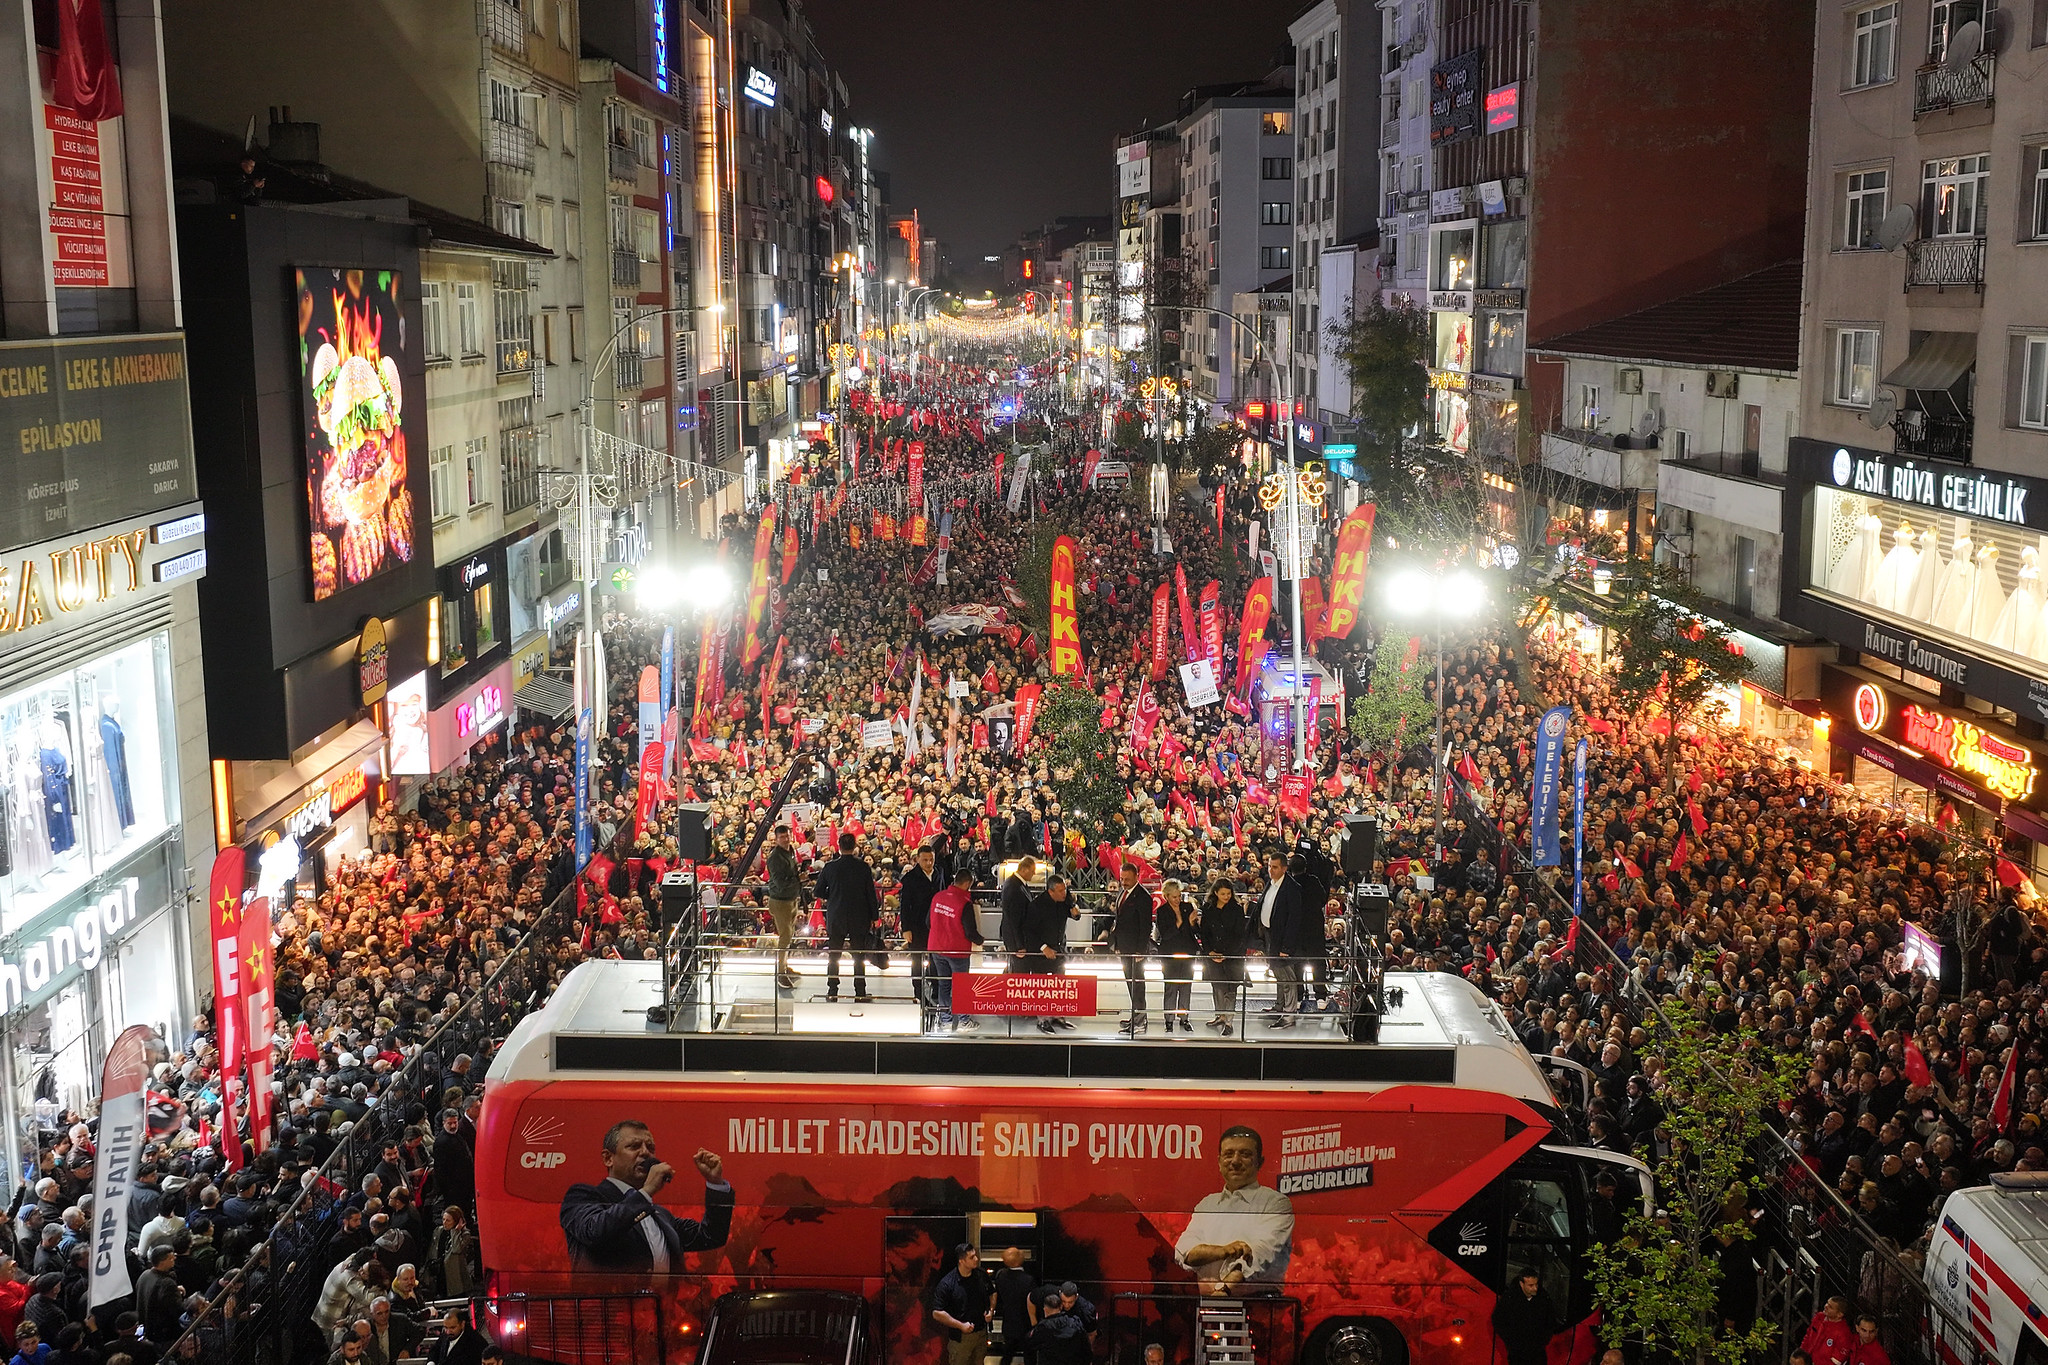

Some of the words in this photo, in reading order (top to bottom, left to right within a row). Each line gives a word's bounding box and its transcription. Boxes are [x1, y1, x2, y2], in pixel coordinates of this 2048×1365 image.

[62, 140, 77, 152] LEKE
[60, 165, 73, 180] KAŞ
[65, 357, 99, 390] LEKE
[102, 366, 111, 387] &
[20, 417, 102, 454] EPİLASYON
[149, 458, 180, 475] SAKARYA
[28, 482, 59, 501] KÖRFEZ
[60, 478, 80, 494] PLUS
[153, 481, 179, 495] DARICA
[1854, 455, 1887, 496] ASİL
[1892, 461, 1936, 506] RÜYA
[1941, 473, 2029, 525] GELİNLİK
[45, 504, 67, 522] İZMİT
[1202, 600, 1216, 612] CHP
[1330, 551, 1365, 634] HKP
[1052, 580, 1081, 675] HKP
[1865, 623, 1906, 661] HAUTE
[1908, 639, 1968, 685] COUTURE
[1278, 701, 1287, 742] CADDESİ
[1901, 704, 1955, 767] Tavuk
[1539, 740, 1556, 826] BELEDİYE
[1535, 836, 1546, 861] İŞ
[0, 876, 140, 1016] hangar
[1006, 976, 1079, 989] CUMHURİYET
[1006, 989, 1035, 999] HALK
[1038, 988, 1079, 1000] PARTİSİ
[972, 1001, 1020, 1013] Türkiye'nin
[1022, 1001, 1049, 1012] Birinci
[1050, 1002, 1078, 1013] Partisi
[728, 1116, 830, 1155] MİLLET
[839, 1118, 985, 1156] İRADESİNE
[994, 1120, 1080, 1158] SAHİP
[1088, 1123, 1203, 1164] ÇIKIYOR
[1281, 1130, 1341, 1154] EKREM
[103, 1124, 134, 1198] FATİH
[520, 1151, 567, 1169] CHP
[1281, 1145, 1396, 1173] İMAMOĞLU'NA
[1280, 1166, 1369, 1194] ÖZGÜRLÜK
[94, 1209, 117, 1277] CHP
[1458, 1244, 1488, 1256] CHP
